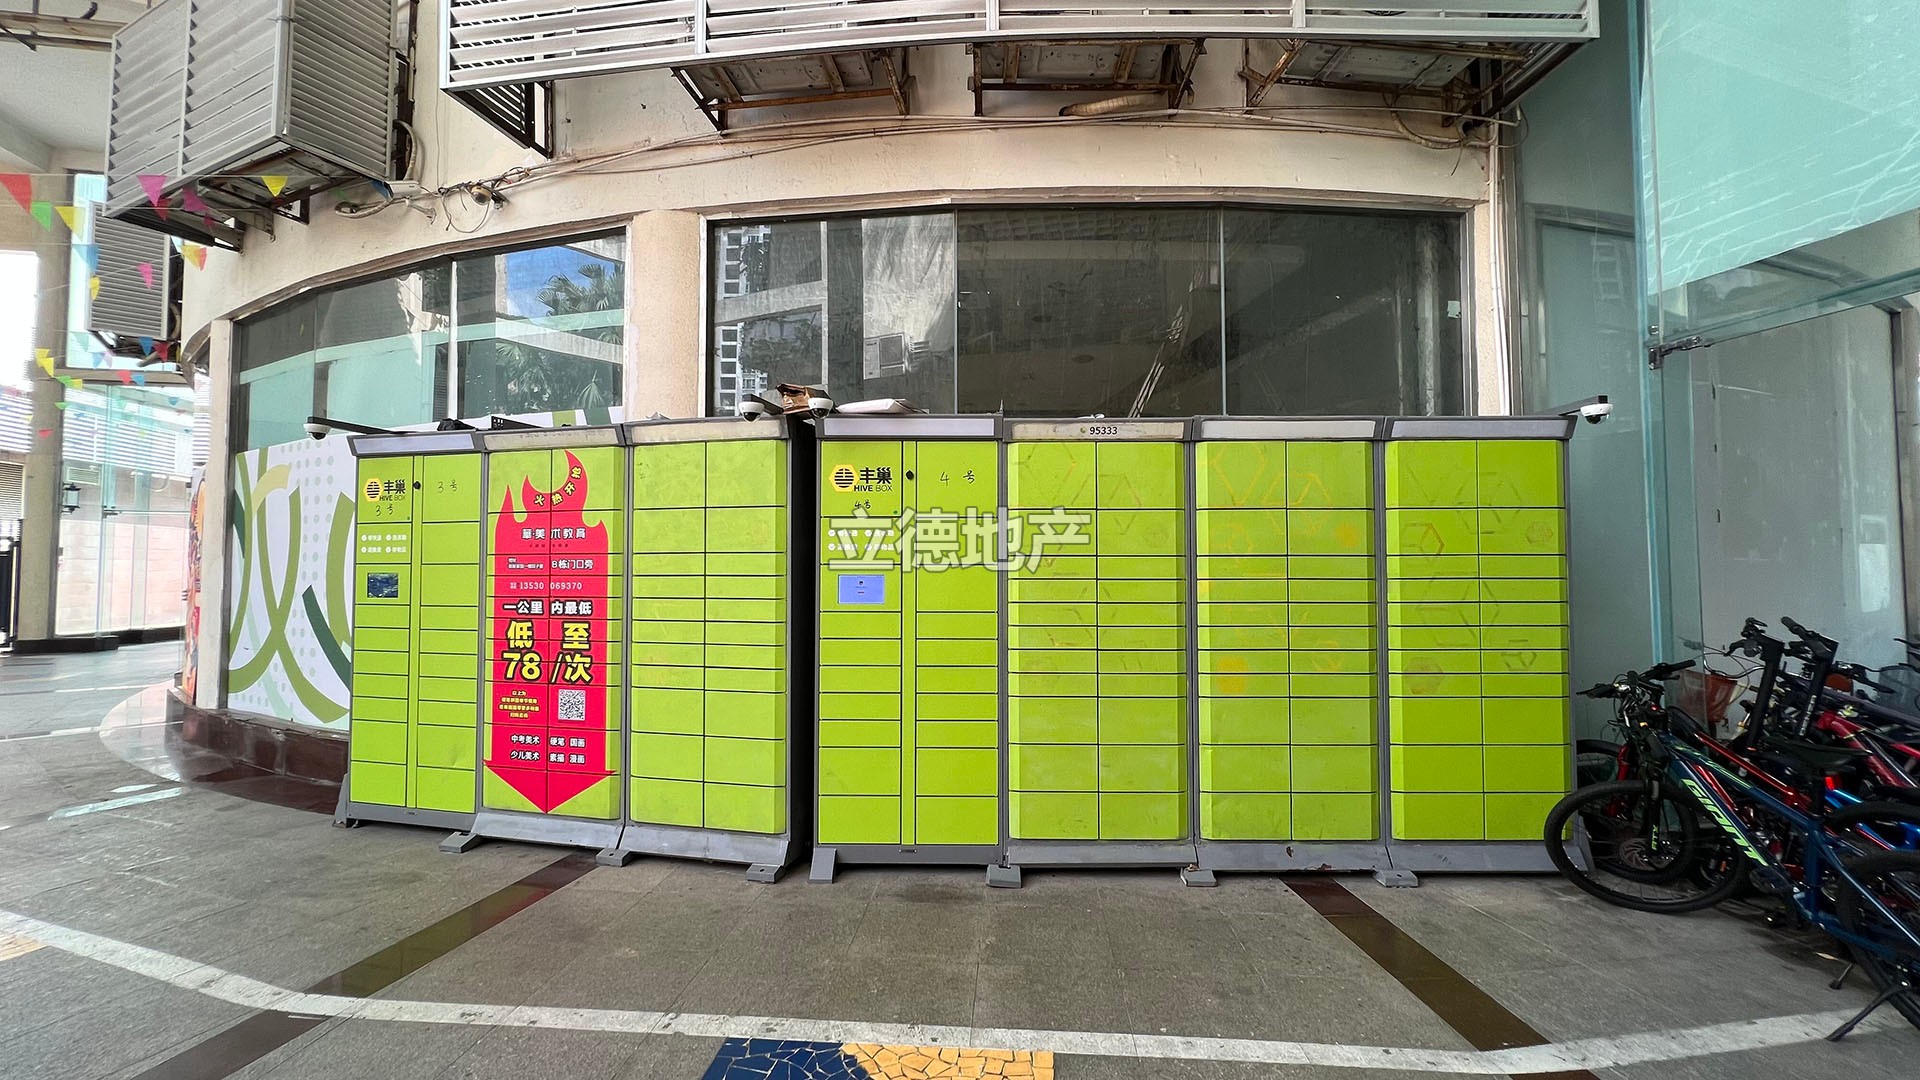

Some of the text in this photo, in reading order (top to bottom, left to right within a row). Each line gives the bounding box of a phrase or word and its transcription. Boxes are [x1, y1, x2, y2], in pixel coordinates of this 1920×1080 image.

[1089, 426, 1118, 435] 95333
[859, 467, 892, 484] 丰巢
[384, 479, 406, 494] 丰巢
[502, 652, 541, 680] 78
[1681, 778, 1769, 867] GIANT
